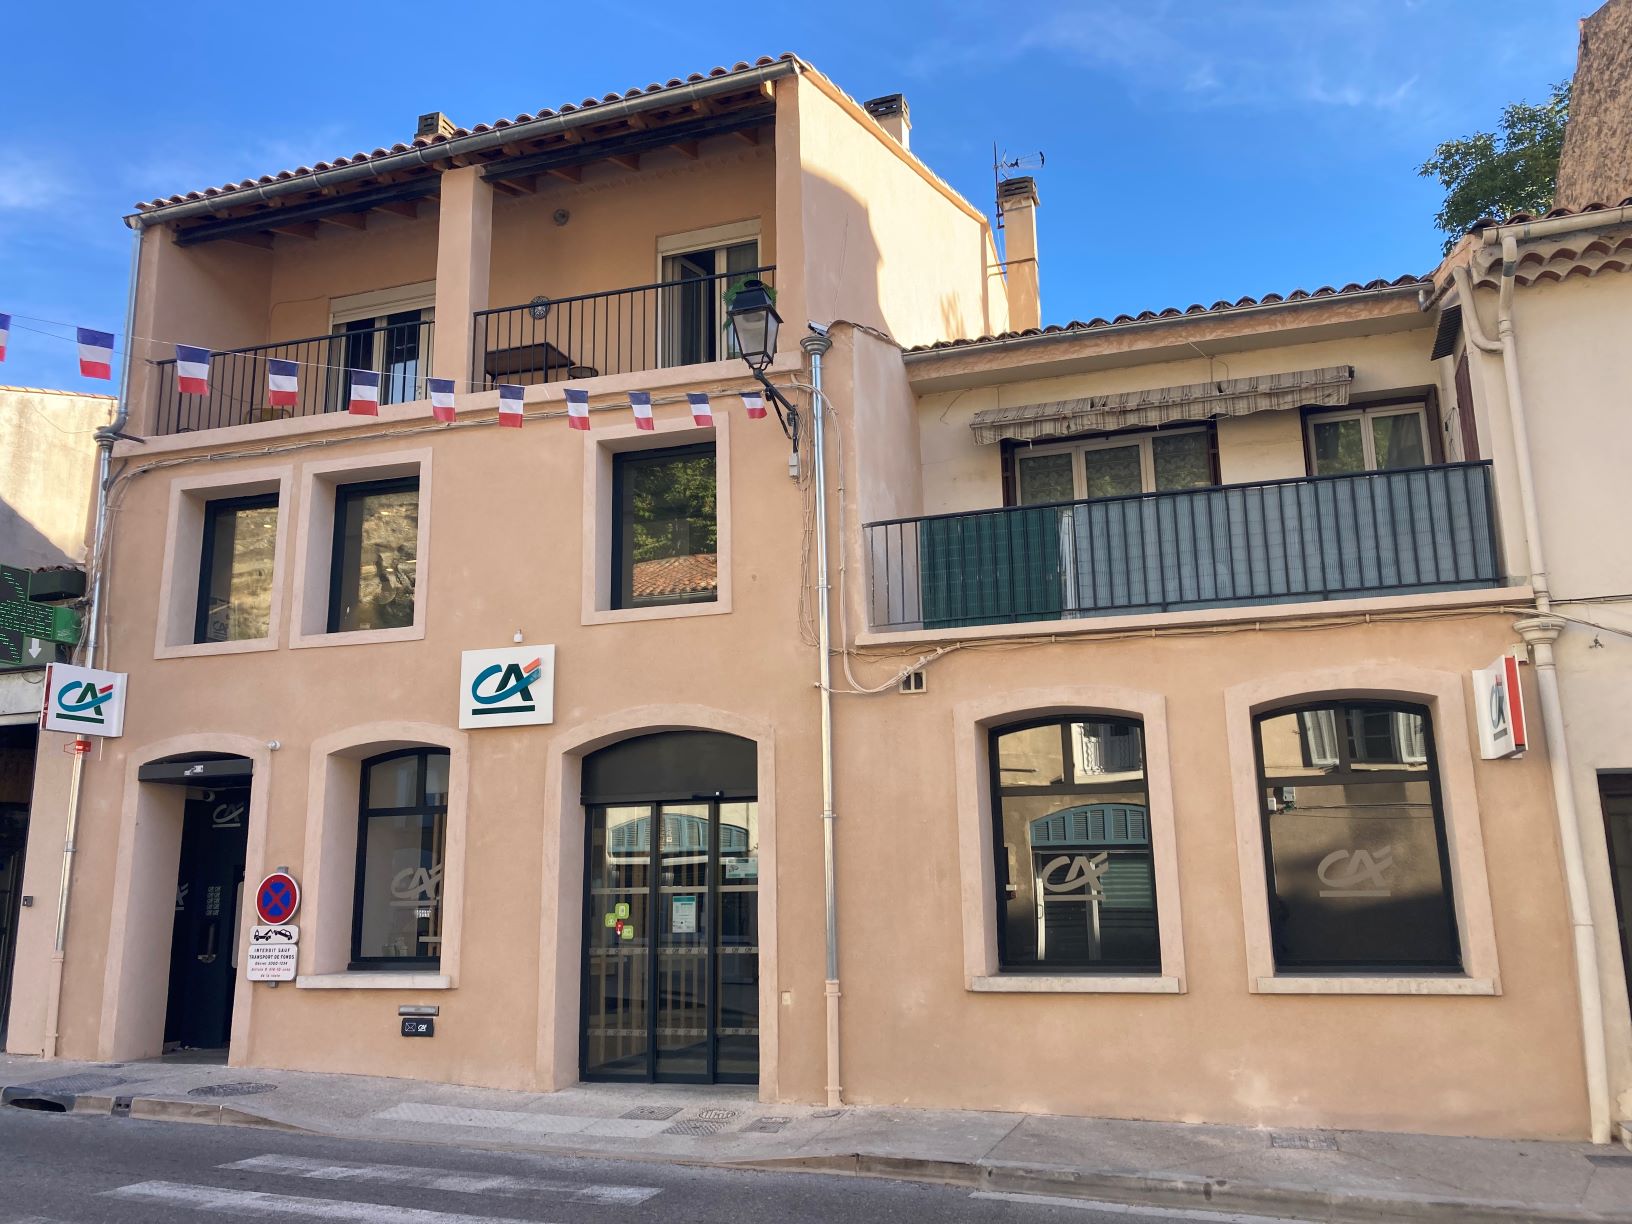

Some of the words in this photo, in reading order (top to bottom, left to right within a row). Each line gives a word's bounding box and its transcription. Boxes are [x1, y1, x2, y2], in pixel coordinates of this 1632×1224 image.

[57, 680, 114, 717] CA
[471, 657, 542, 705] CA
[391, 864, 442, 899] CA
[1042, 851, 1109, 893] CA
[1317, 845, 1393, 888] CA
